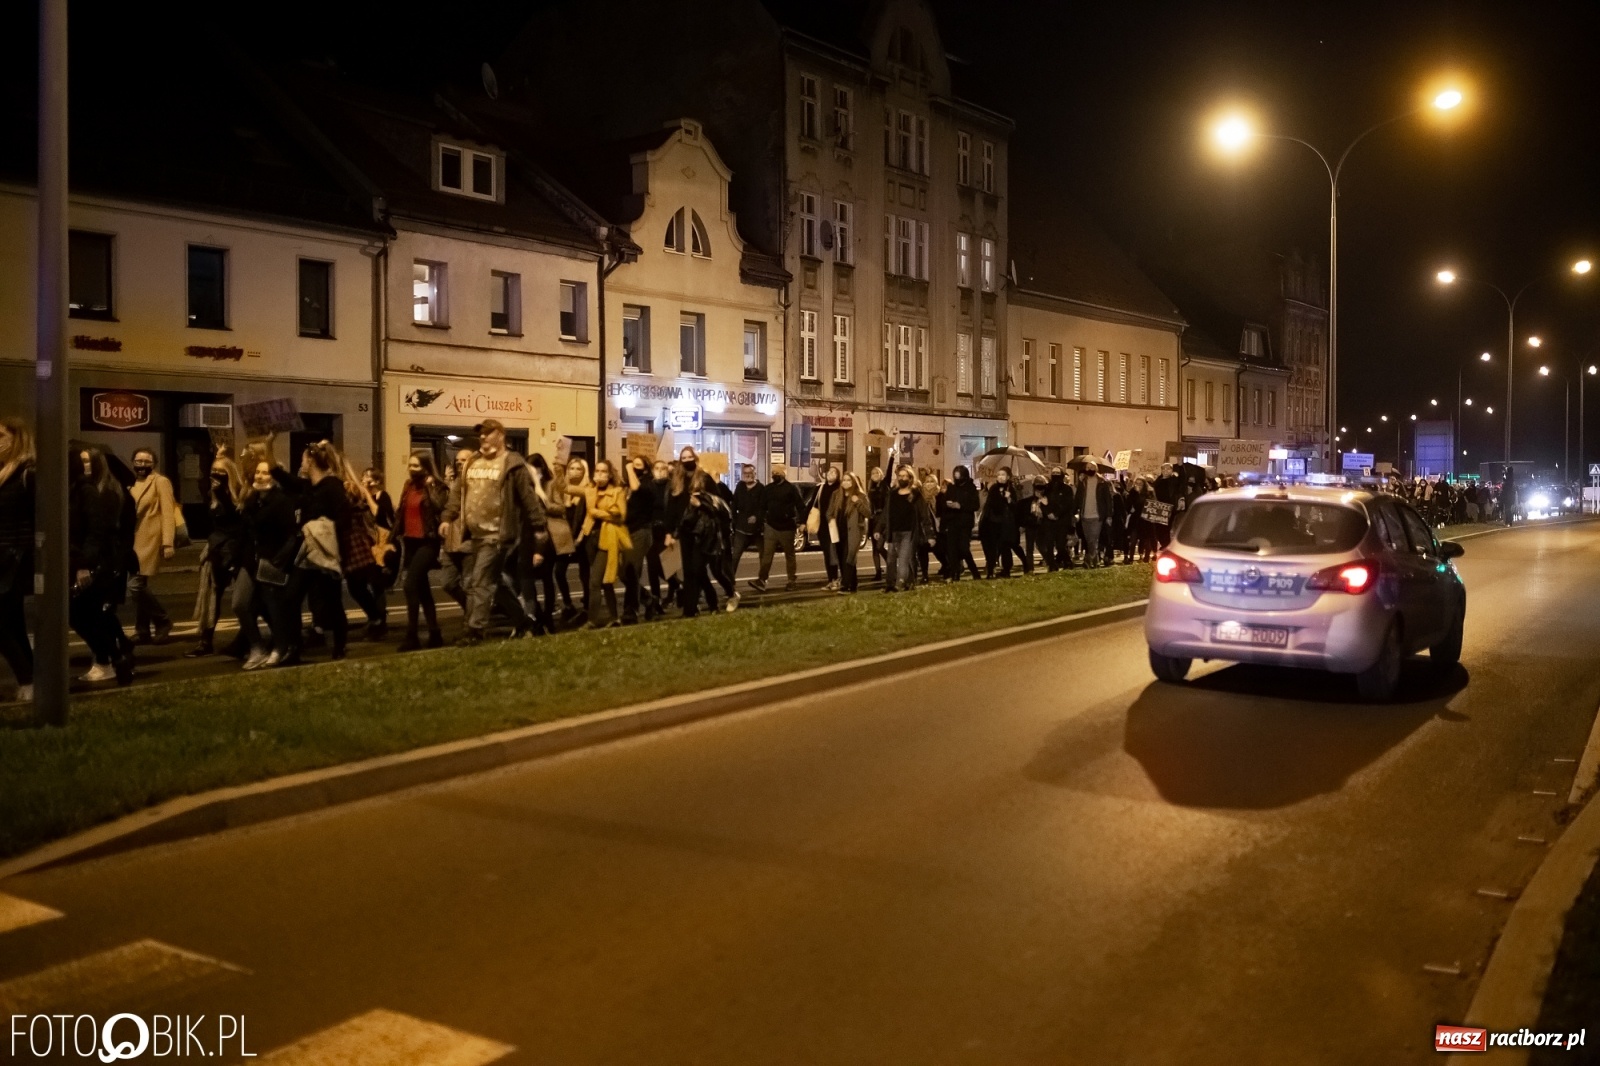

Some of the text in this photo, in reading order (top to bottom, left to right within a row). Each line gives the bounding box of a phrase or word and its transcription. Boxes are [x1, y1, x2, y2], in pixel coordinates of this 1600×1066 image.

[688, 387, 736, 404] NAPRAWA
[358, 403, 369, 412] 53
[445, 395, 471, 413] Ani
[475, 394, 523, 413] Ciuszek
[99, 401, 144, 422] Berger
[1221, 443, 1265, 453] W OBRONIE
[1221, 455, 1262, 466] WOLNOŚCI
[1268, 577, 1294, 589] P109
